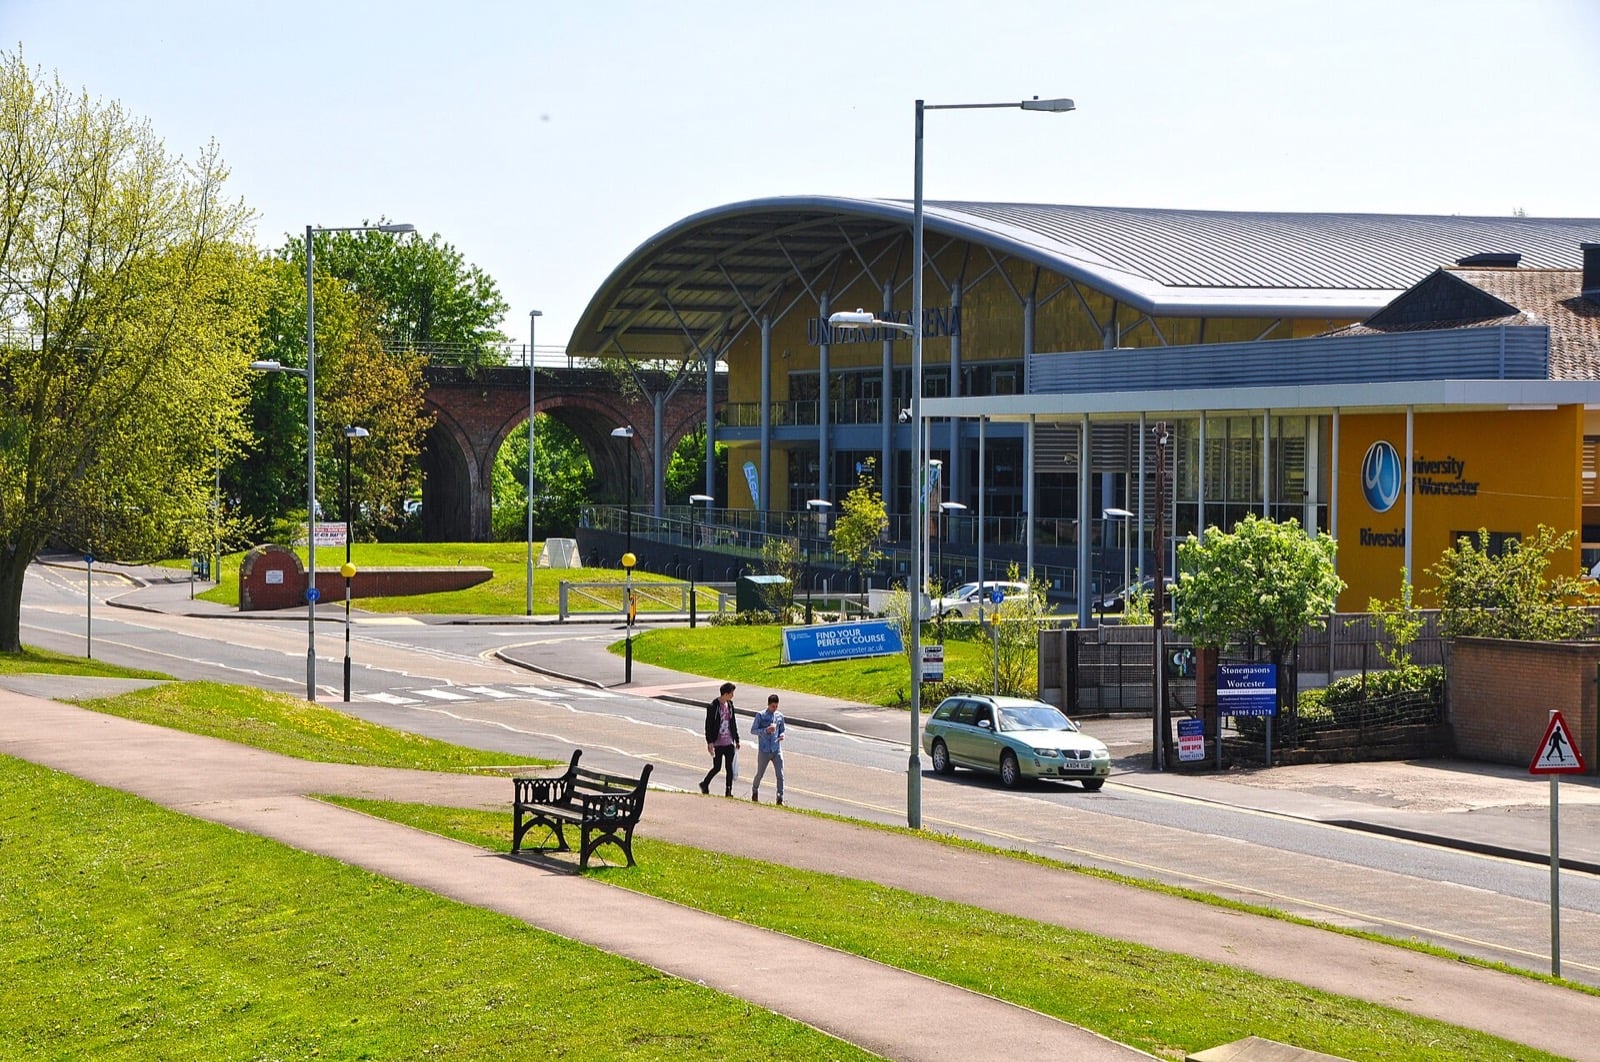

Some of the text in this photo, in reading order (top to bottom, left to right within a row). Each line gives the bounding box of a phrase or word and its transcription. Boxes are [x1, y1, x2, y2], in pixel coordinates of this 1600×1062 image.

[1419, 477, 1479, 496] Worcester
[1360, 527, 1405, 547] Riversid
[816, 631, 836, 640] FIND
[837, 628, 861, 638] YOUR
[817, 634, 885, 647] PERFECT COURSE
[818, 644, 884, 656] www.worcester.ac.uk
[1221, 666, 1270, 674] Stonemasons
[1227, 680, 1265, 688] Worcester
